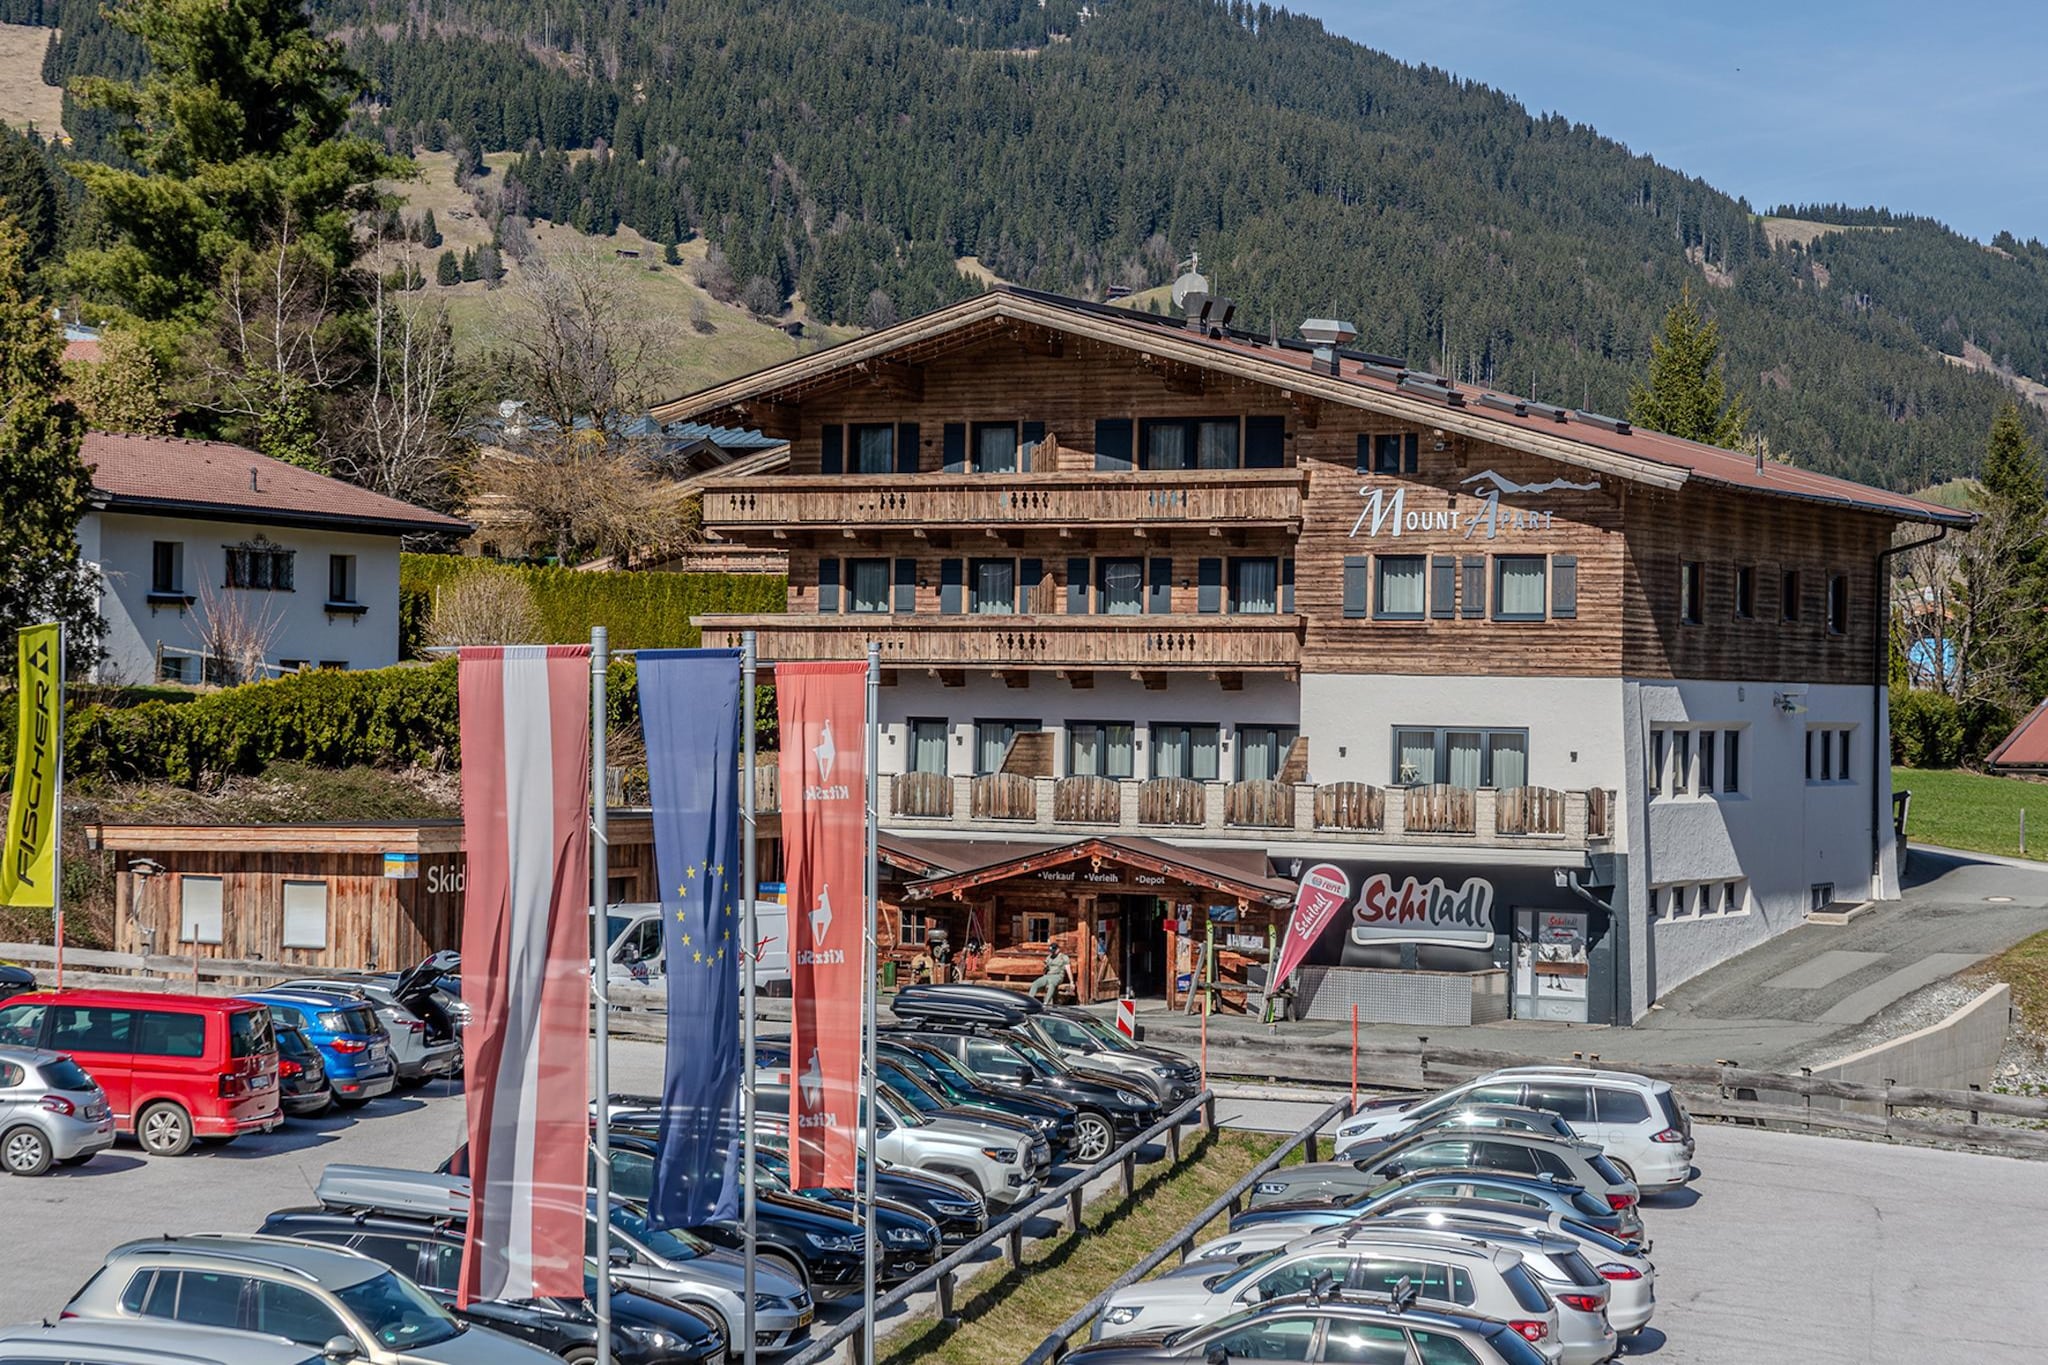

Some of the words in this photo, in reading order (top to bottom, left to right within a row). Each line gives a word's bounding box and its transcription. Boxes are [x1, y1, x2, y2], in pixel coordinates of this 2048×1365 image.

[17, 679, 49, 888] FISCHER
[1042, 871, 1075, 881] Verkauf
[1088, 873, 1118, 883] Verleih
[1139, 875, 1165, 886] Depot
[1321, 880, 1342, 893] rent
[1295, 892, 1329, 936] Schiladl
[1357, 879, 1486, 928] Schiladl
